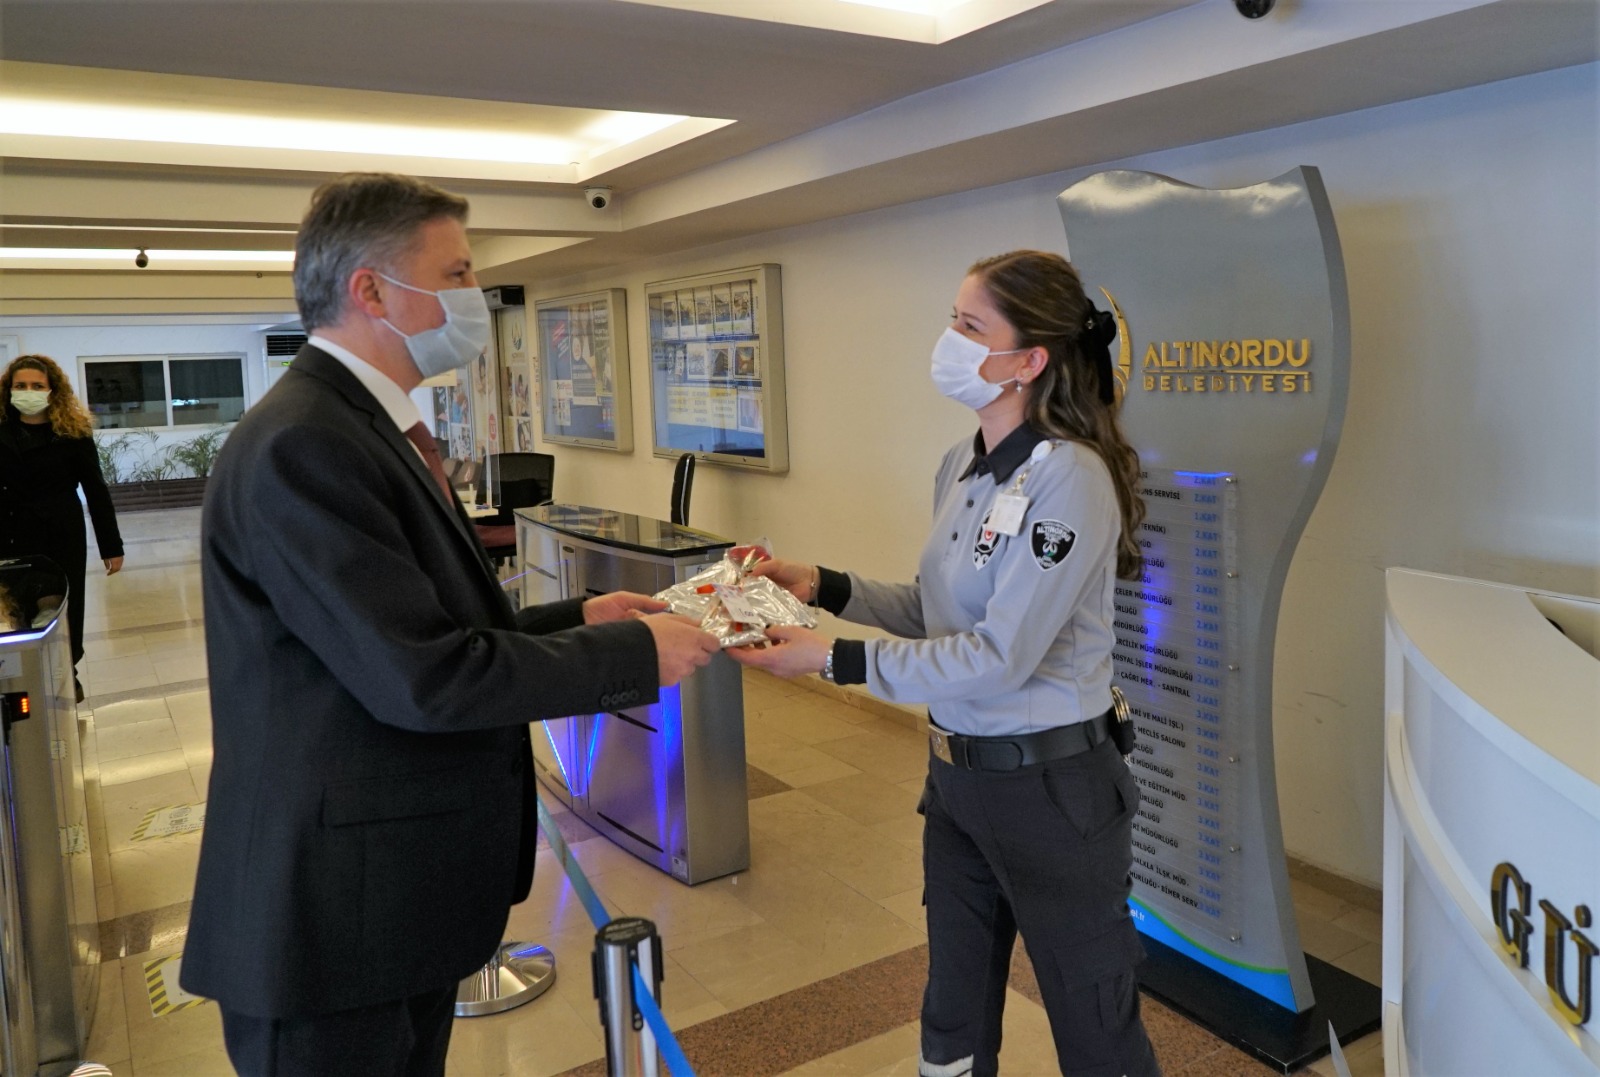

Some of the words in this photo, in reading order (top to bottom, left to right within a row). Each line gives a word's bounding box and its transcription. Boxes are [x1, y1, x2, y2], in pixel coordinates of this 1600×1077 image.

[1143, 338, 1311, 368] ALTINORDU
[1143, 374, 1312, 393] BELEDİYESİ
[1154, 489, 1180, 500] SERVİSİ
[1134, 591, 1172, 606] MÜDÜRLÜĞÜ
[1140, 644, 1178, 660] MÜDÜRLÜĞÜ
[1112, 652, 1134, 665] SOSYAL
[1136, 658, 1152, 670] İŞLER
[1154, 663, 1193, 682] MÜDÜRLÜĞÜ
[1162, 683, 1190, 698] SANTRAL
[1142, 710, 1151, 720] VE
[1152, 713, 1167, 725] MALİ
[1138, 726, 1160, 740] MECLİS
[1160, 734, 1186, 748] SALONU
[1136, 758, 1174, 778] MÜDÜRLÜĞÜ
[1148, 780, 1170, 794] EĞİTİM
[1141, 826, 1178, 848] MÜDÜRLÜĞÜ
